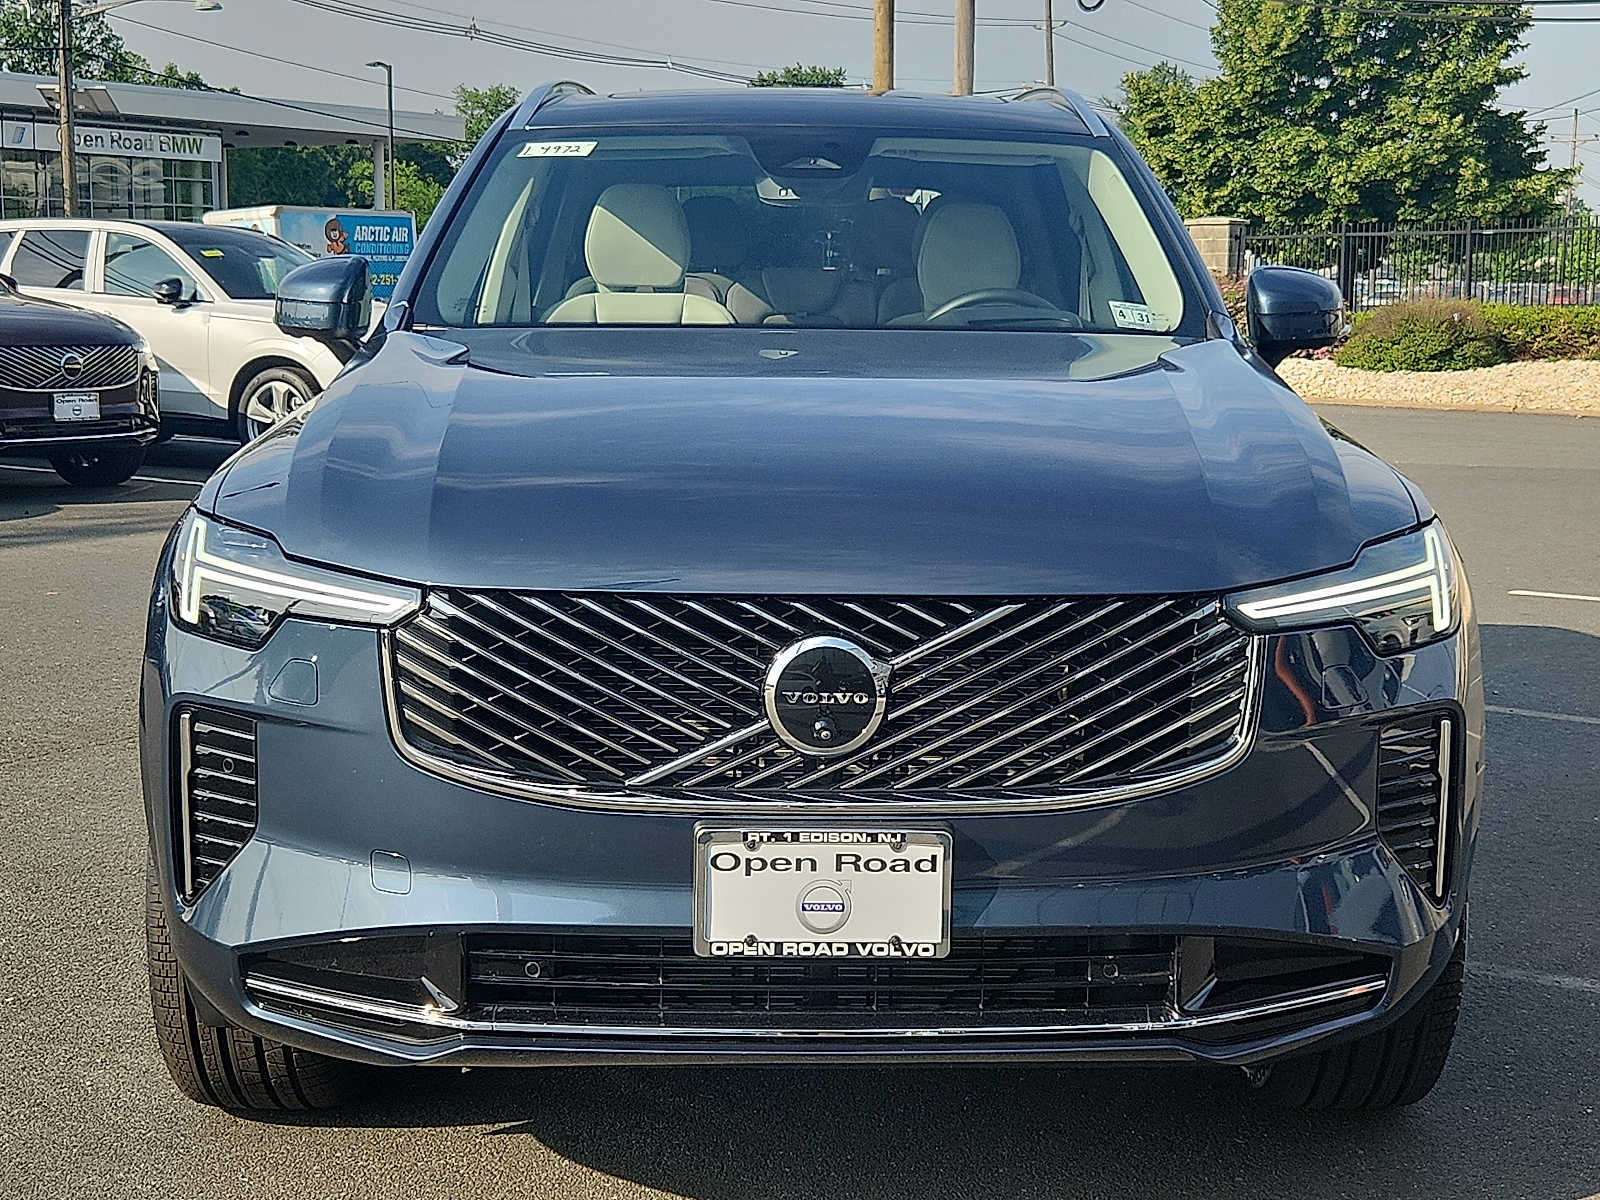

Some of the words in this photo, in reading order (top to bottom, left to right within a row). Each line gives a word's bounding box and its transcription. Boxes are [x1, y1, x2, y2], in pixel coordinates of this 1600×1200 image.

[110, 131, 154, 151] Road
[159, 135, 203, 154] BMW
[354, 226, 390, 241] ARCTIC
[391, 227, 409, 242] AIR
[355, 242, 410, 254] CONDITIONING
[782, 691, 869, 704] VOLVO
[747, 832, 775, 843] RT.
[799, 832, 872, 844] EDISON,
[878, 832, 901, 843] NJ
[710, 853, 818, 876] Open
[835, 853, 938, 873] Road
[803, 903, 843, 911] VOLVO
[711, 942, 775, 956] OPEN
[782, 942, 849, 956] ROAD
[855, 942, 935, 956] VOLVO
